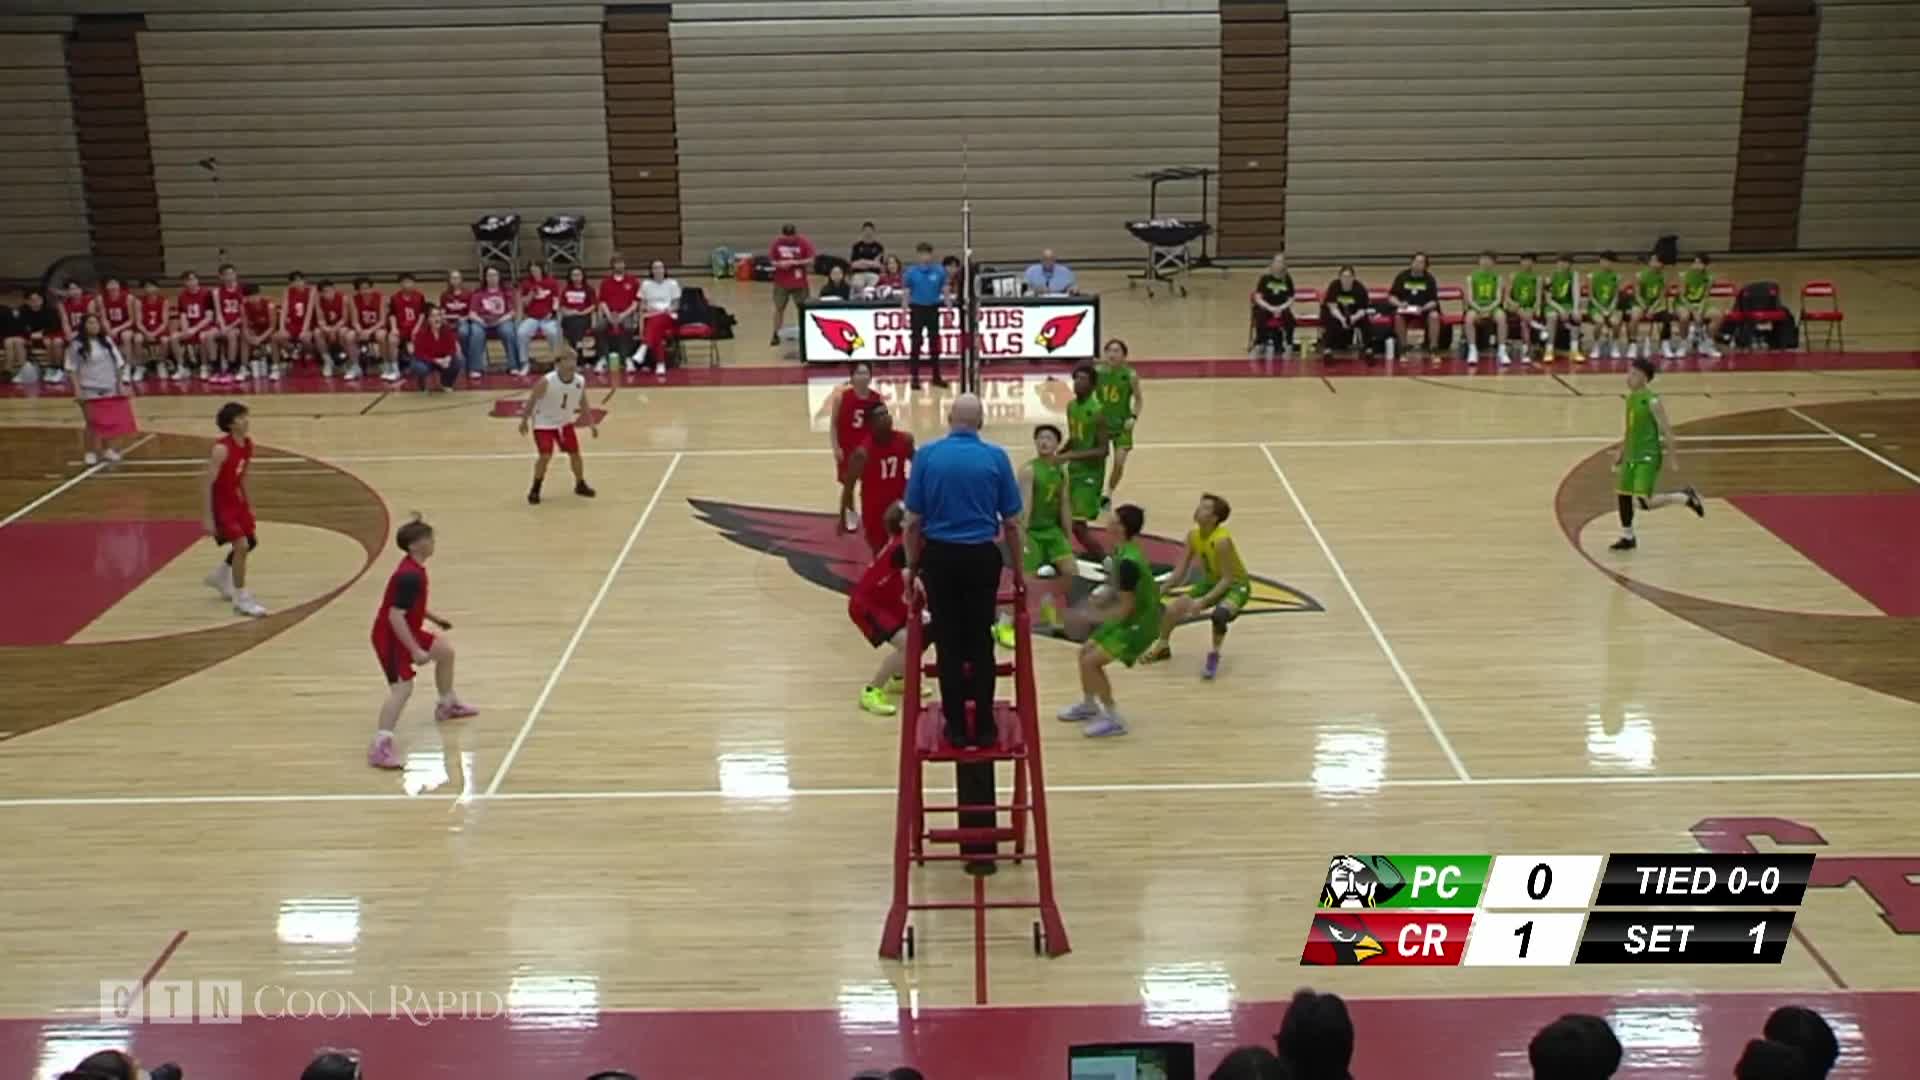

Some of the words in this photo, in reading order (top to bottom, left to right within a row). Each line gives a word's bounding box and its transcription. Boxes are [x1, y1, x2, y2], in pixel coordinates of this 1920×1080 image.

[1103, 384, 1120, 402] 16
[852, 408, 865, 429] 5
[880, 455, 899, 480] 17
